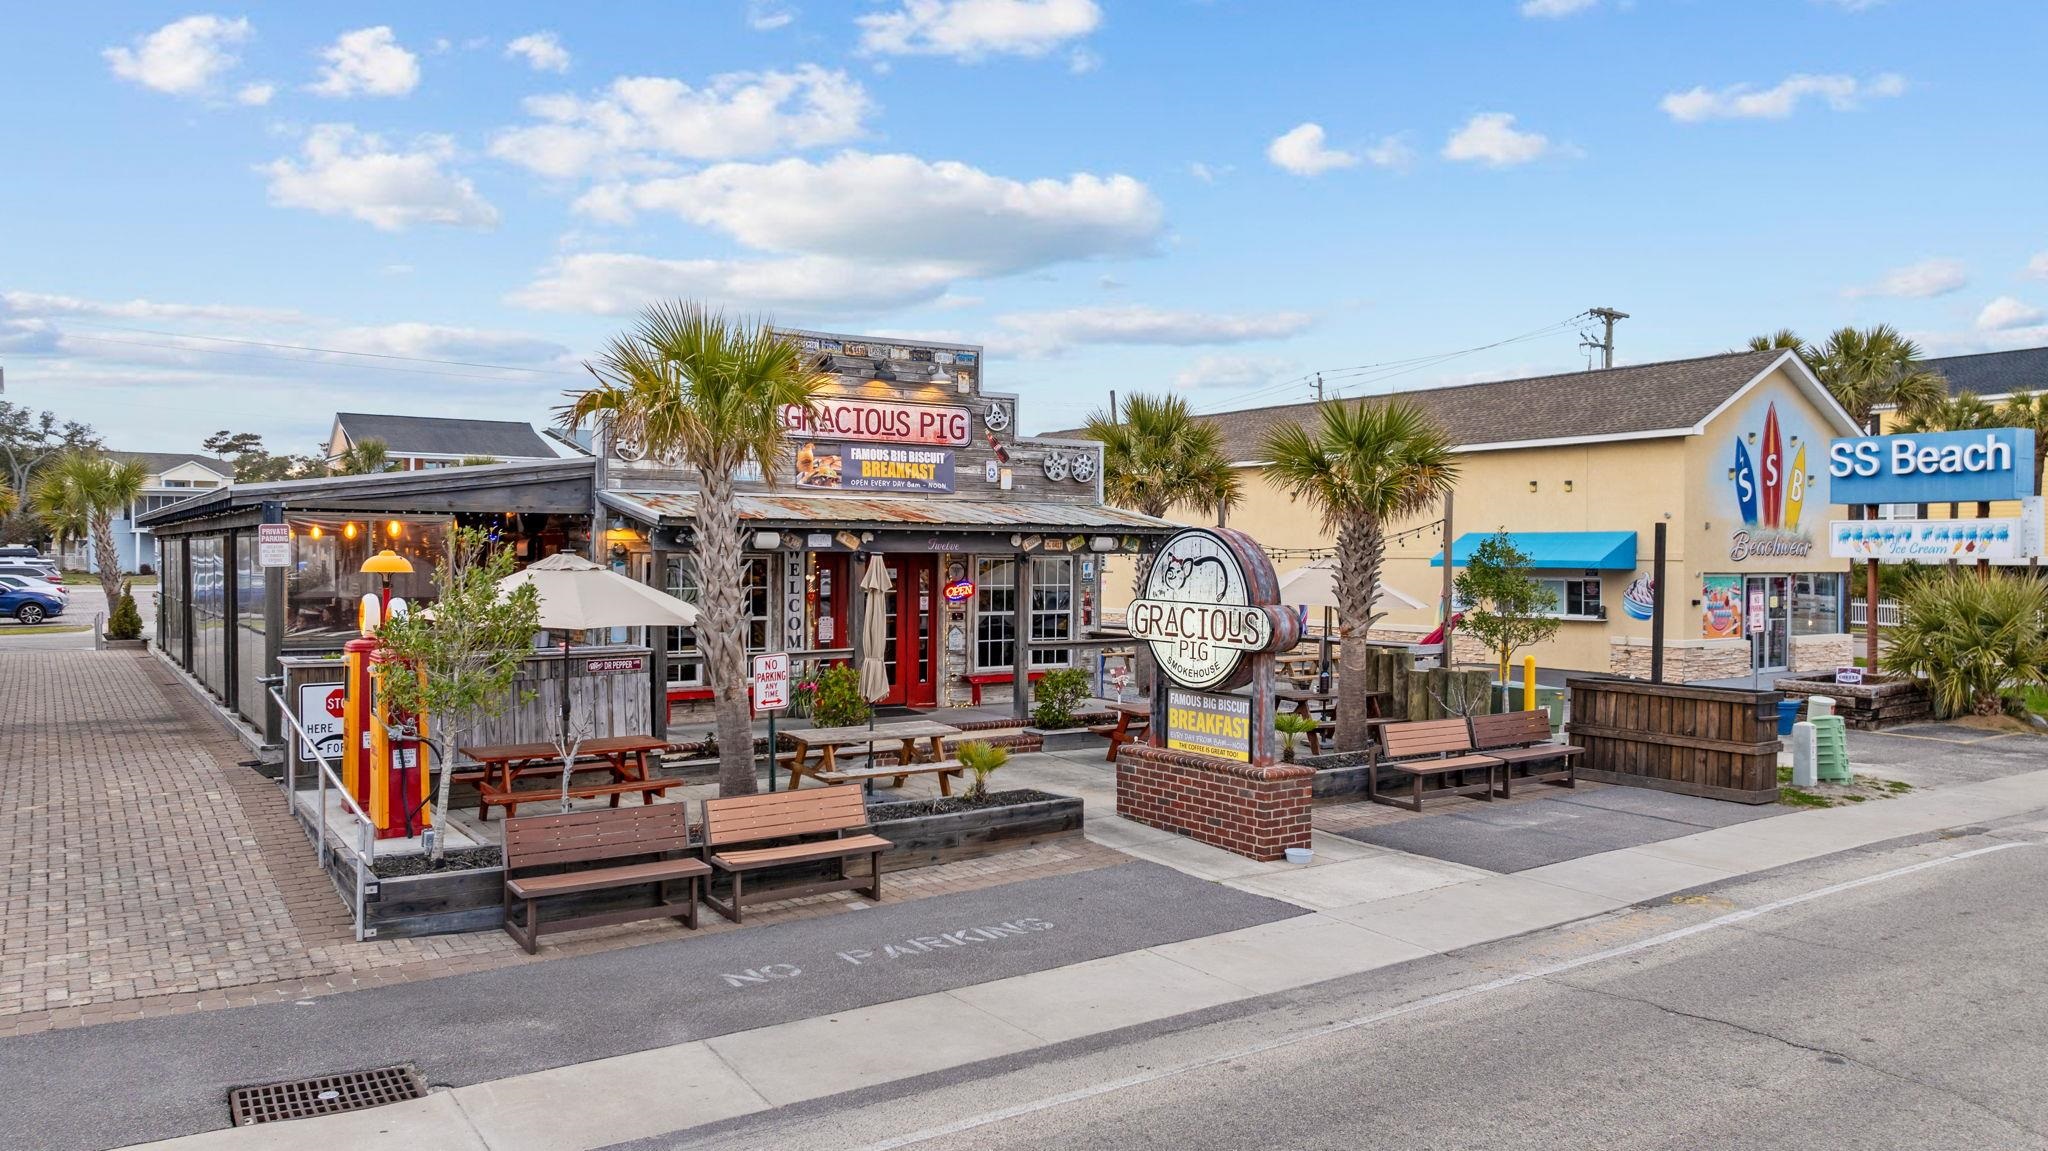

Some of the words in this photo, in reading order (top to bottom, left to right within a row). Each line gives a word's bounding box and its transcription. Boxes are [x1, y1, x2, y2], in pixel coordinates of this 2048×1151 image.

[919, 412, 966, 440] PIG
[850, 447, 890, 462] FAMOUS
[890, 449, 907, 463] BIG
[908, 450, 946, 465] BISCUIT
[1829, 442, 1881, 478] SS
[1891, 433, 2012, 475] Beach
[861, 460, 936, 480] BREAKFAST
[850, 479, 869, 487] OPEN
[870, 479, 891, 488] EVERY
[892, 480, 906, 488] DAY
[906, 480, 921, 489] 8am
[927, 481, 947, 490] NOON
[261, 535, 289, 543] PARKING
[1730, 529, 1813, 561] Beachwear
[1888, 541, 1908, 555] Ice
[1909, 542, 1947, 555] Cream
[946, 585, 973, 597] OPEN
[1134, 603, 1260, 645] GRACIOUS
[1179, 640, 1209, 661] PIG
[612, 660, 633, 669] PEPPER
[764, 659, 778, 670] NO
[1166, 656, 1221, 678] SMOKEHOUSE
[756, 670, 786, 682] PARKING
[764, 682, 778, 690] ANY
[764, 690, 779, 698] TIME
[327, 697, 344, 710] STO
[1170, 692, 1202, 708] FAMOUS
[1202, 696, 1217, 710] BIG
[1218, 698, 1249, 715] BISCUIT
[307, 723, 334, 734] HERE
[1169, 707, 1249, 740] BREAKFAST
[1179, 742, 1188, 750] THE
[1188, 743, 1205, 753] COFFEE
[1211, 747, 1226, 756] GREAT
[1226, 750, 1239, 758] TOO!
[719, 963, 802, 988] NO
